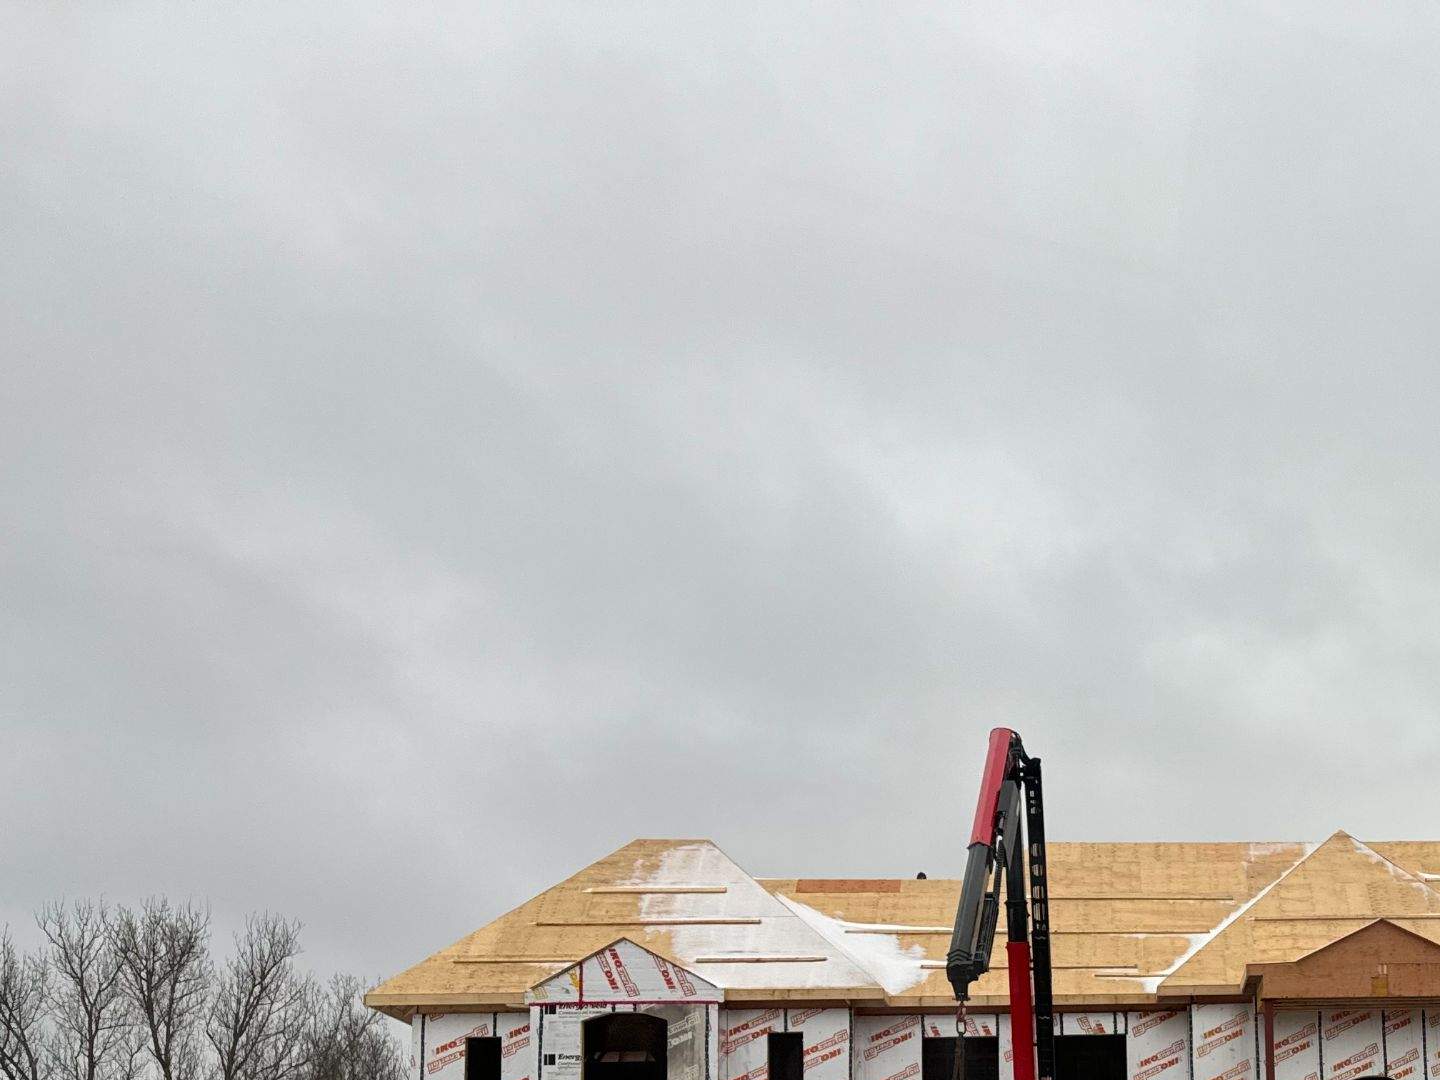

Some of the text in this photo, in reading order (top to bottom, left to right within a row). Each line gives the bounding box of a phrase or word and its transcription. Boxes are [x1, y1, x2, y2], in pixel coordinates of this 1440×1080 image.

[509, 1024, 530, 1038] IKO
[729, 1024, 749, 1036] IKO
[871, 1028, 891, 1042] IKO
[893, 1032, 912, 1045] IKO
[436, 1041, 457, 1054] IKO
[821, 1049, 841, 1061] IKO
[1354, 1062, 1373, 1074] IKO
